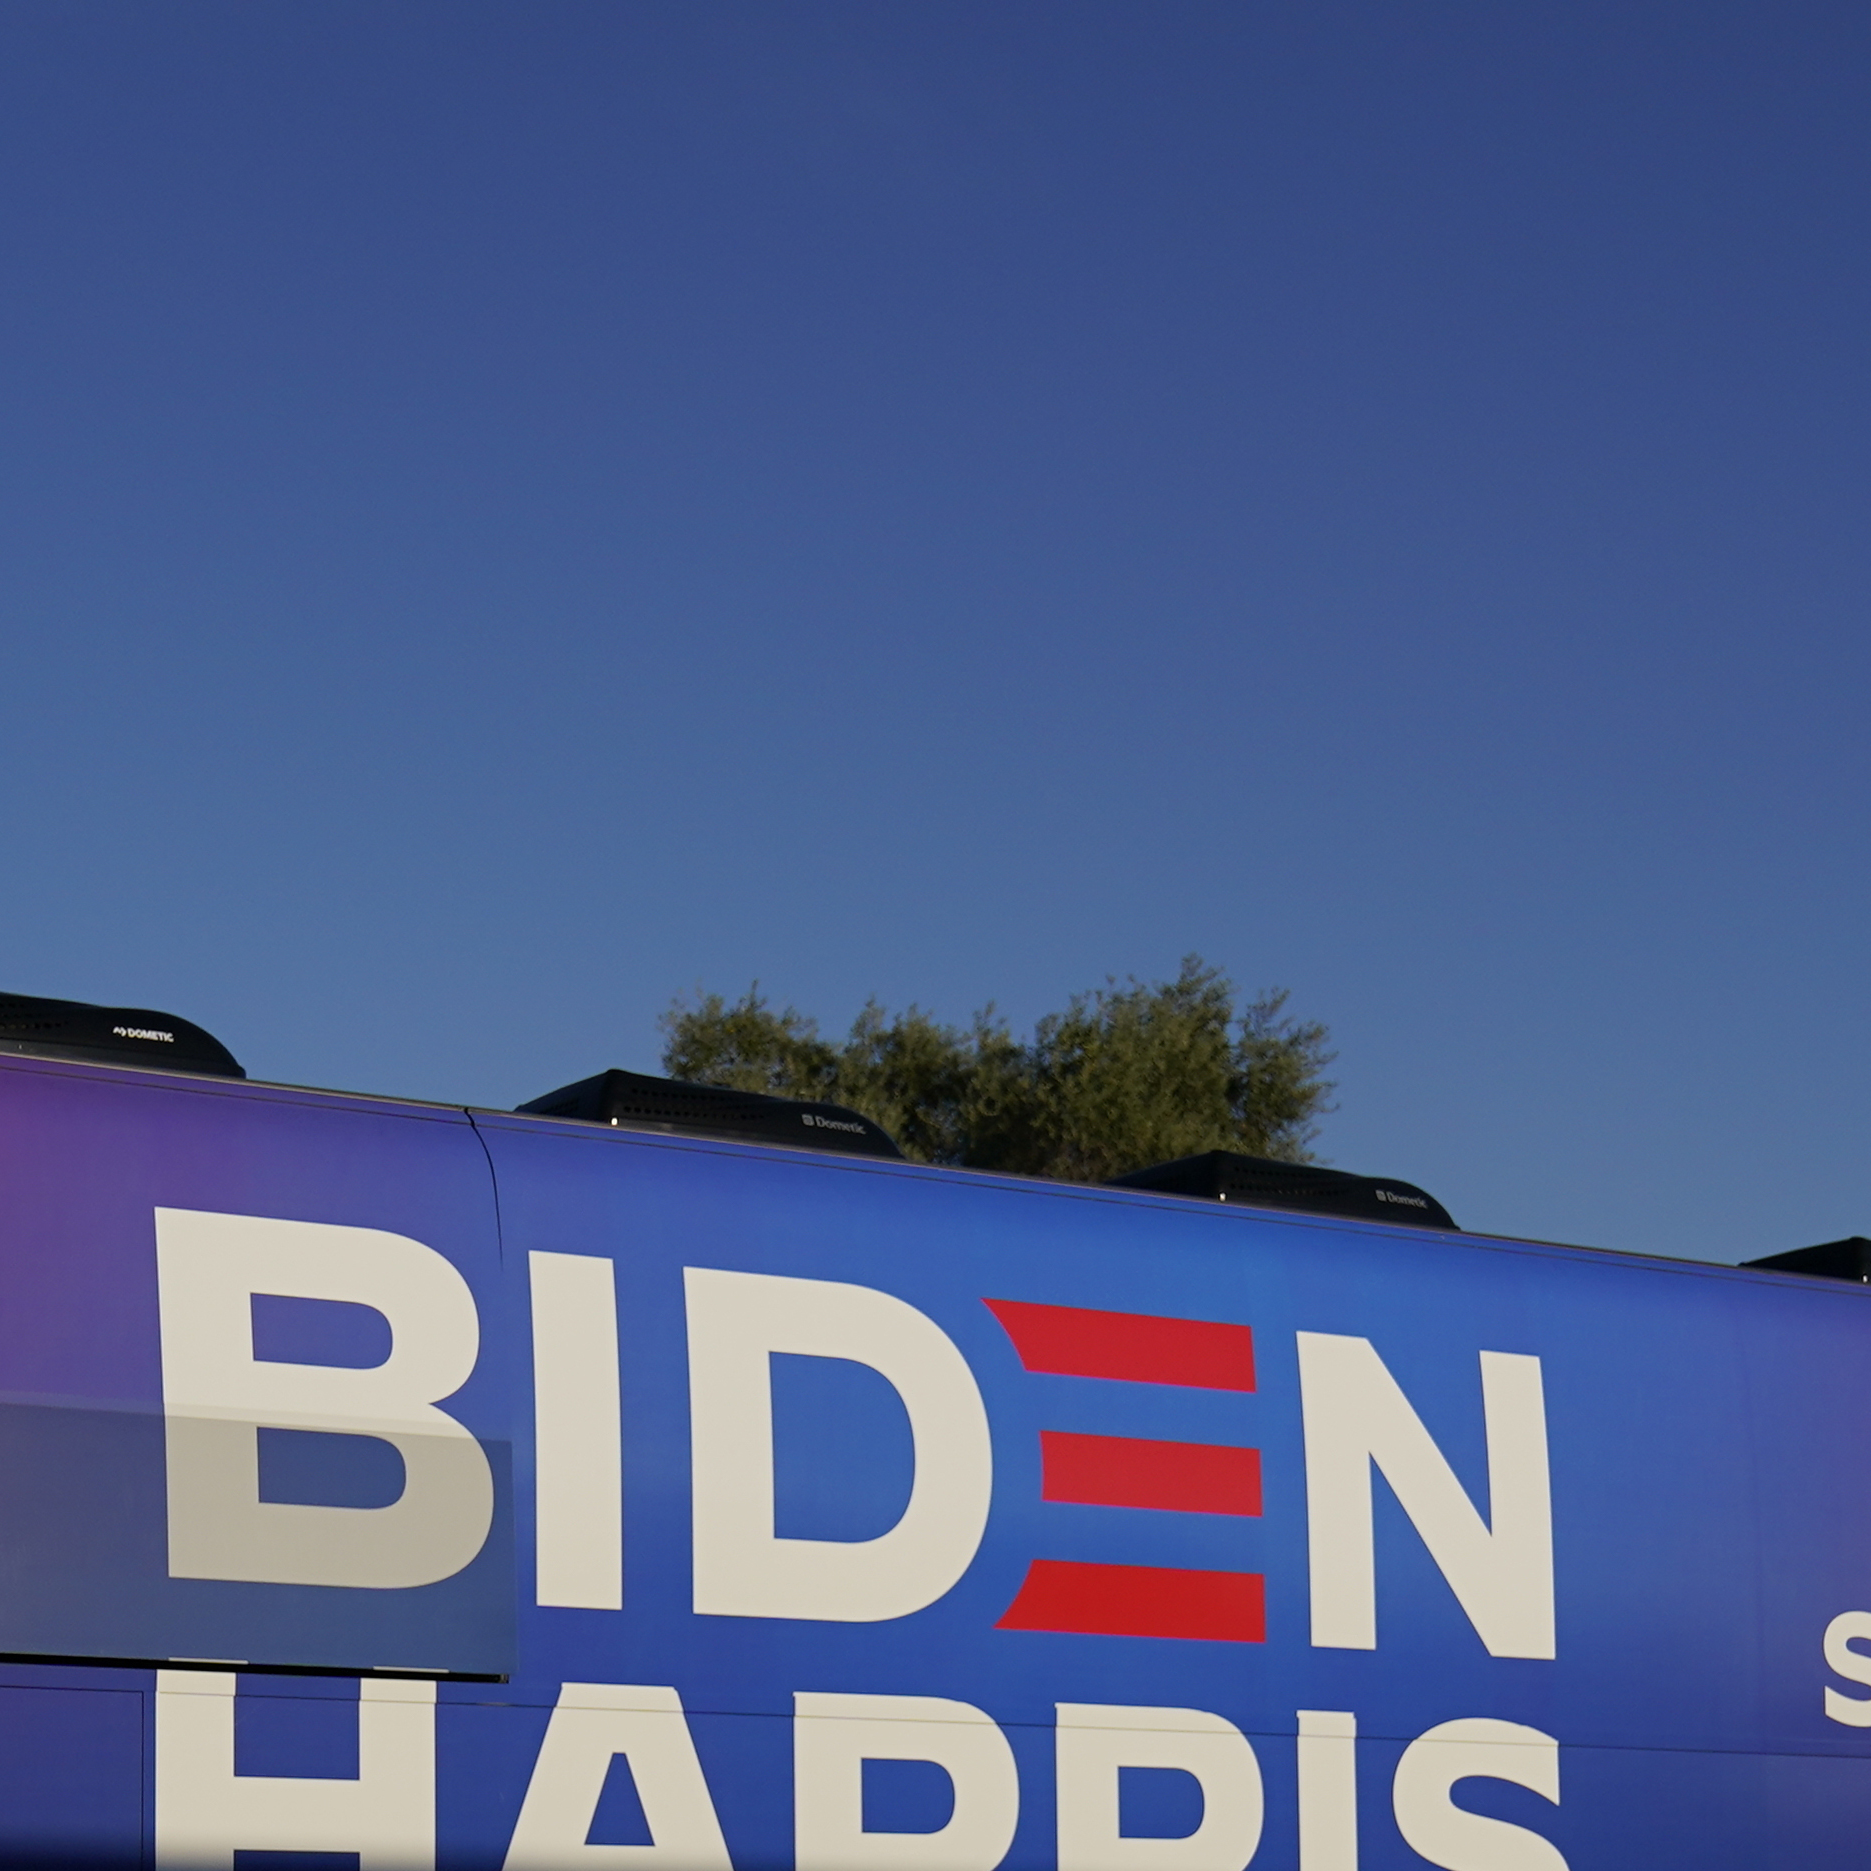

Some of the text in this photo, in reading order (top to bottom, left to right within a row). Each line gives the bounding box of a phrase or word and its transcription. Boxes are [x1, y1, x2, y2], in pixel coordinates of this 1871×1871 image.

[127, 1026, 175, 1043] DOMETIC
[814, 1115, 867, 1136] Dometic
[1386, 1191, 1429, 1210] Dometic
[155, 1207, 1559, 1661] BIDEN
